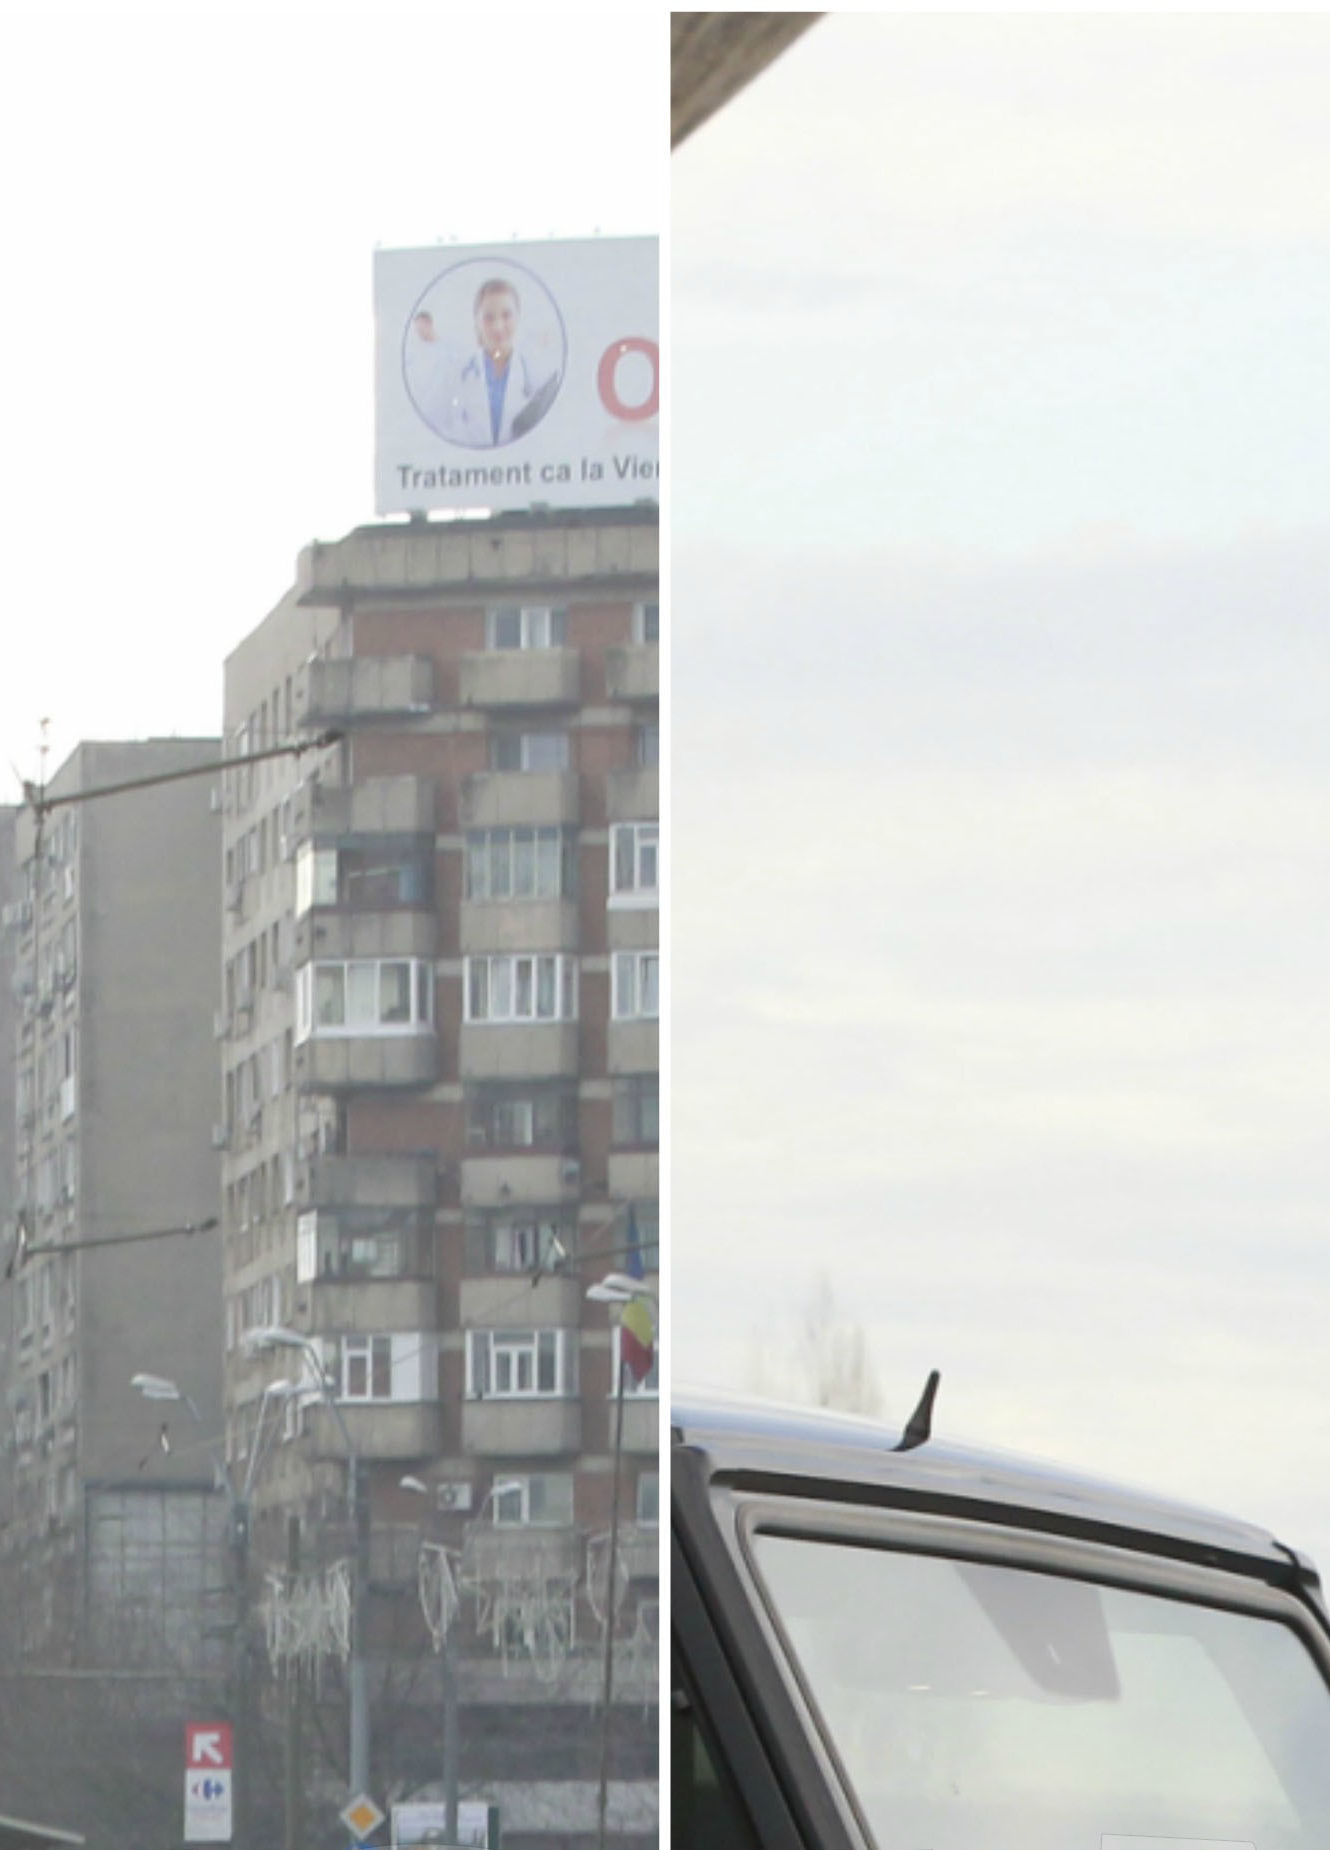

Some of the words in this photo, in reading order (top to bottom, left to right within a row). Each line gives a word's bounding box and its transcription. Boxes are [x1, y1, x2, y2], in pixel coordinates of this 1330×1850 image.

[397, 465, 532, 490] Tratament
[540, 463, 571, 483] ca
[580, 458, 604, 480] la
